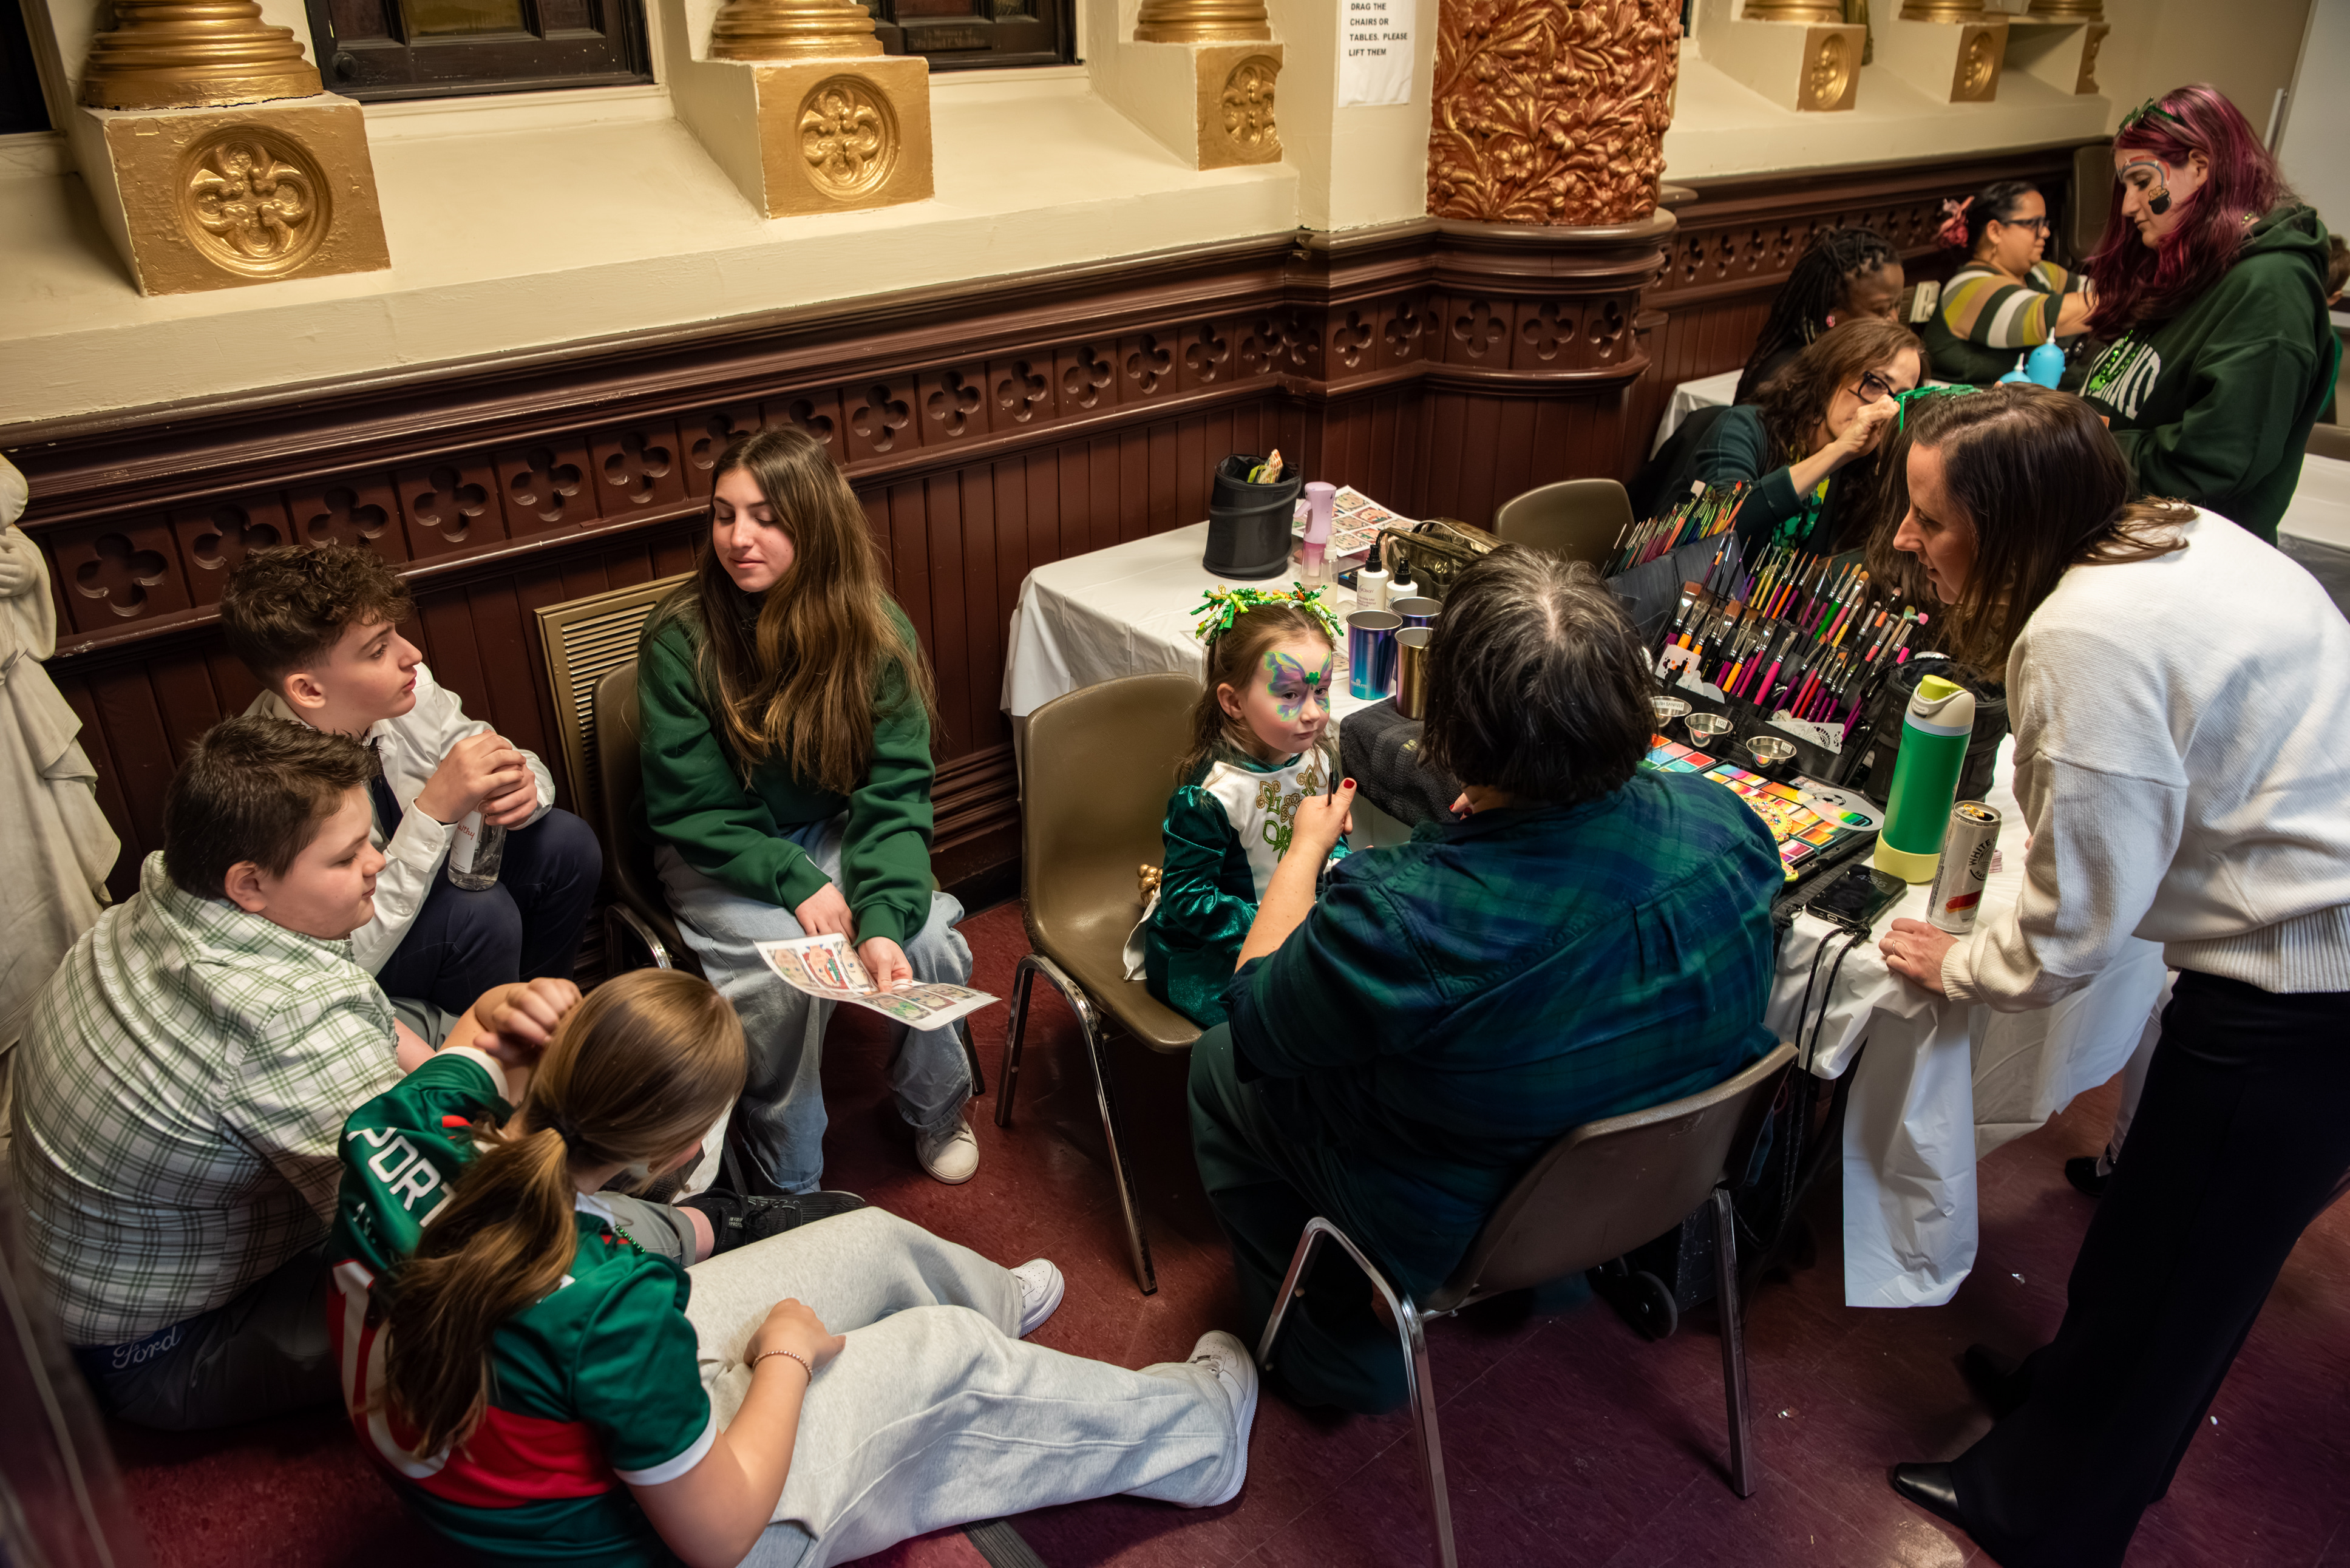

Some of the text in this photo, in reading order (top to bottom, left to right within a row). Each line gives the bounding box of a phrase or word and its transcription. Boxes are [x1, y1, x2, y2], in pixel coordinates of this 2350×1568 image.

[1383, 32, 1408, 41] PLEASE
[1969, 838, 1991, 866] WHITE
[112, 1325, 182, 1369] Ford
